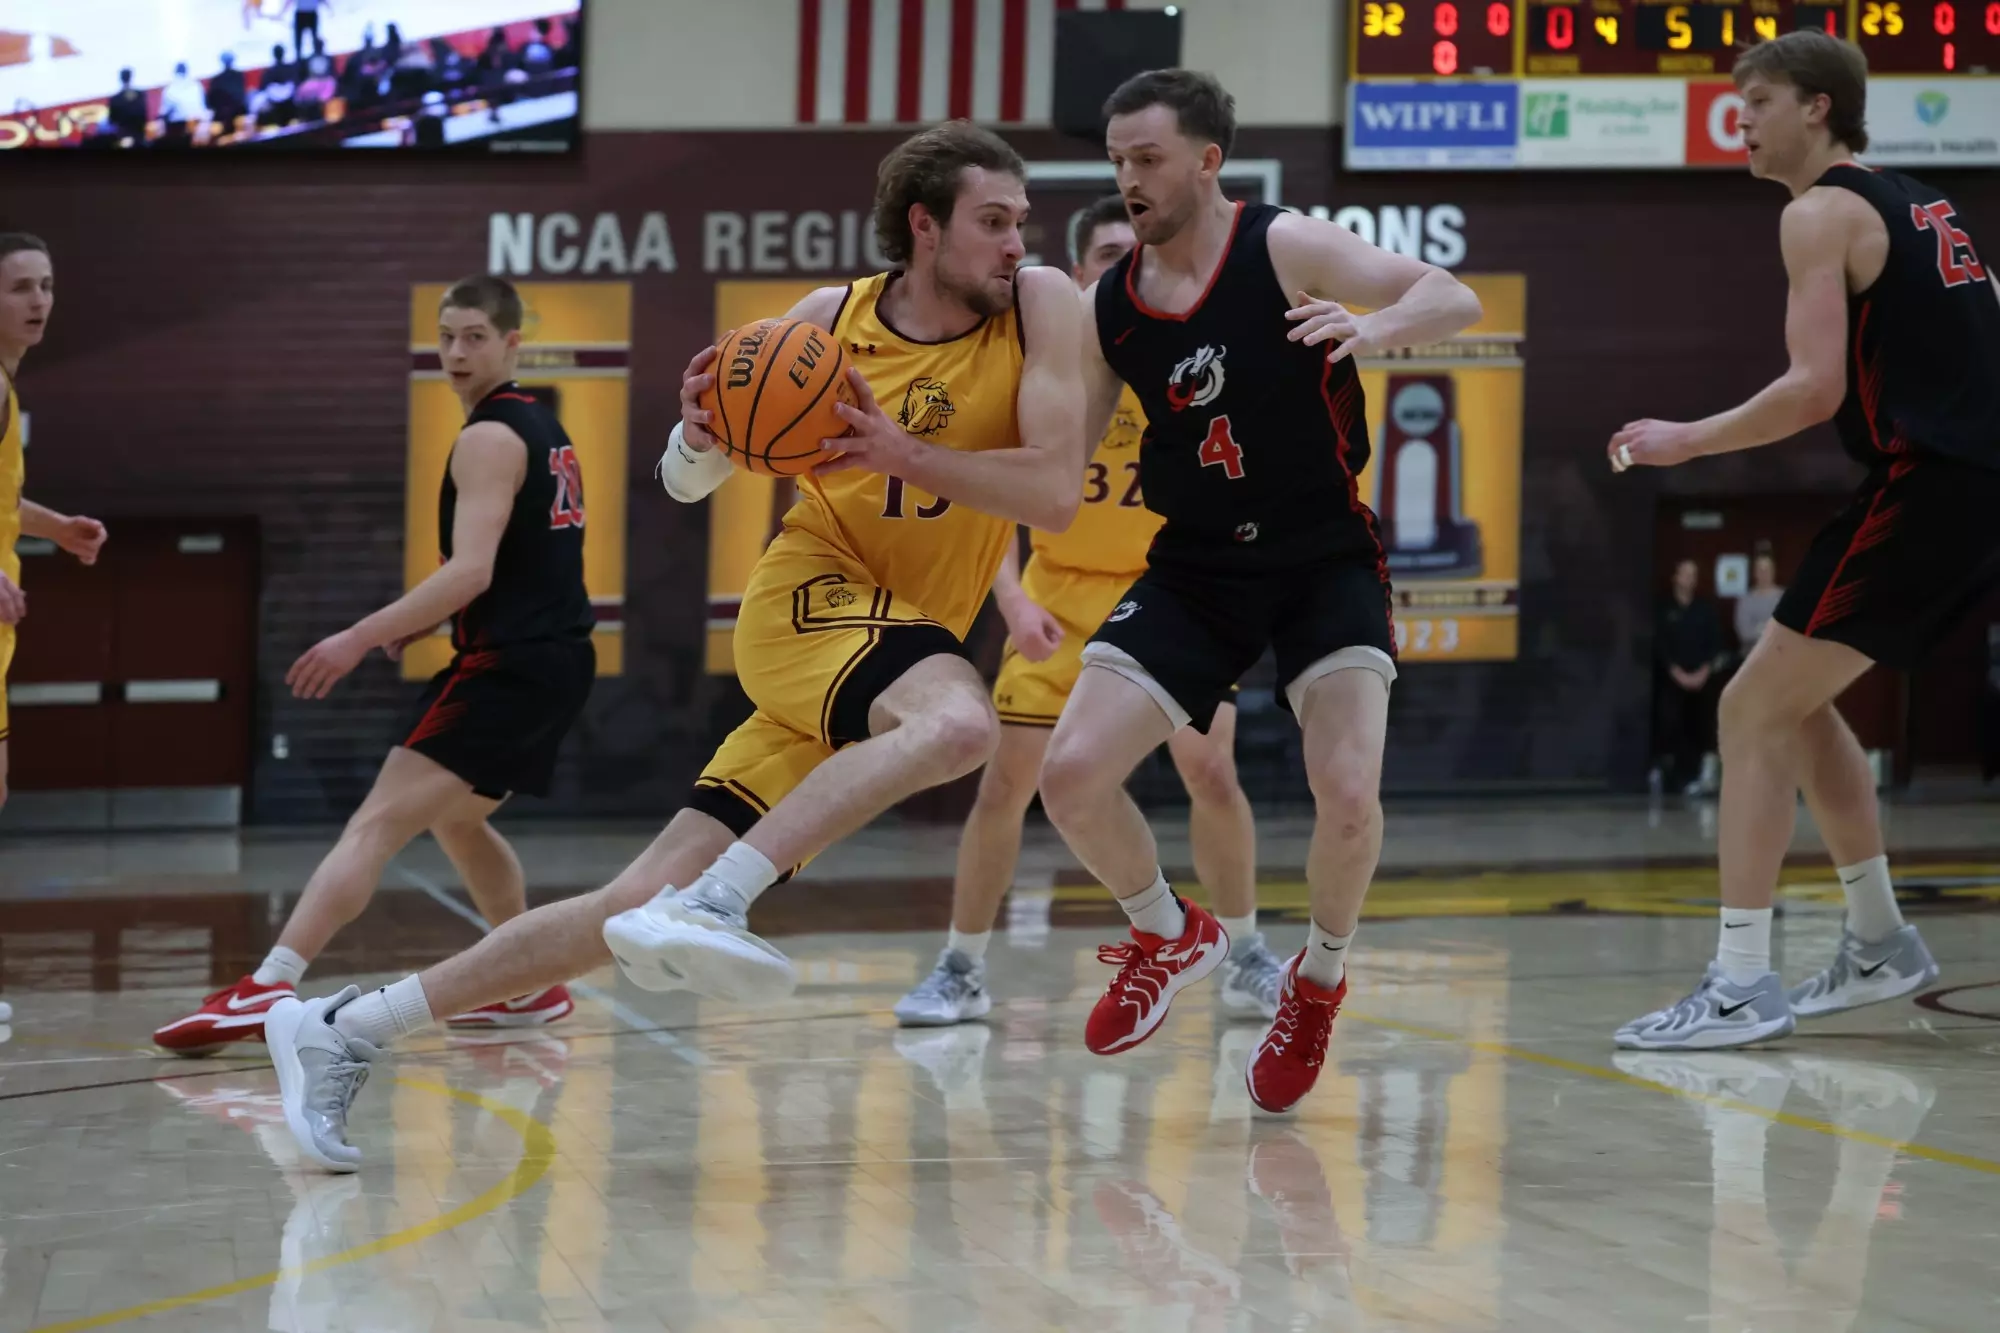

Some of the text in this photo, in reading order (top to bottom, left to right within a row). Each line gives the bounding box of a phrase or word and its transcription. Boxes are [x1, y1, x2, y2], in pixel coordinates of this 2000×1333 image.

[1363, 2, 1405, 36] 32
[1434, 2, 1458, 36] 0
[1487, 2, 1510, 36] 0
[1546, 6, 1574, 49] 0
[1594, 16, 1618, 44] 4
[1862, 2, 1904, 36] 25
[1934, 2, 1955, 36] 0
[1943, 42, 1955, 70] 1
[1359, 101, 1507, 132] WIPFLI
[488, 211, 678, 275] NCAA
[1910, 199, 1987, 288] 25
[1197, 414, 1246, 480] 4
[548, 445, 585, 529] 20
[1083, 461, 1144, 508] 32
